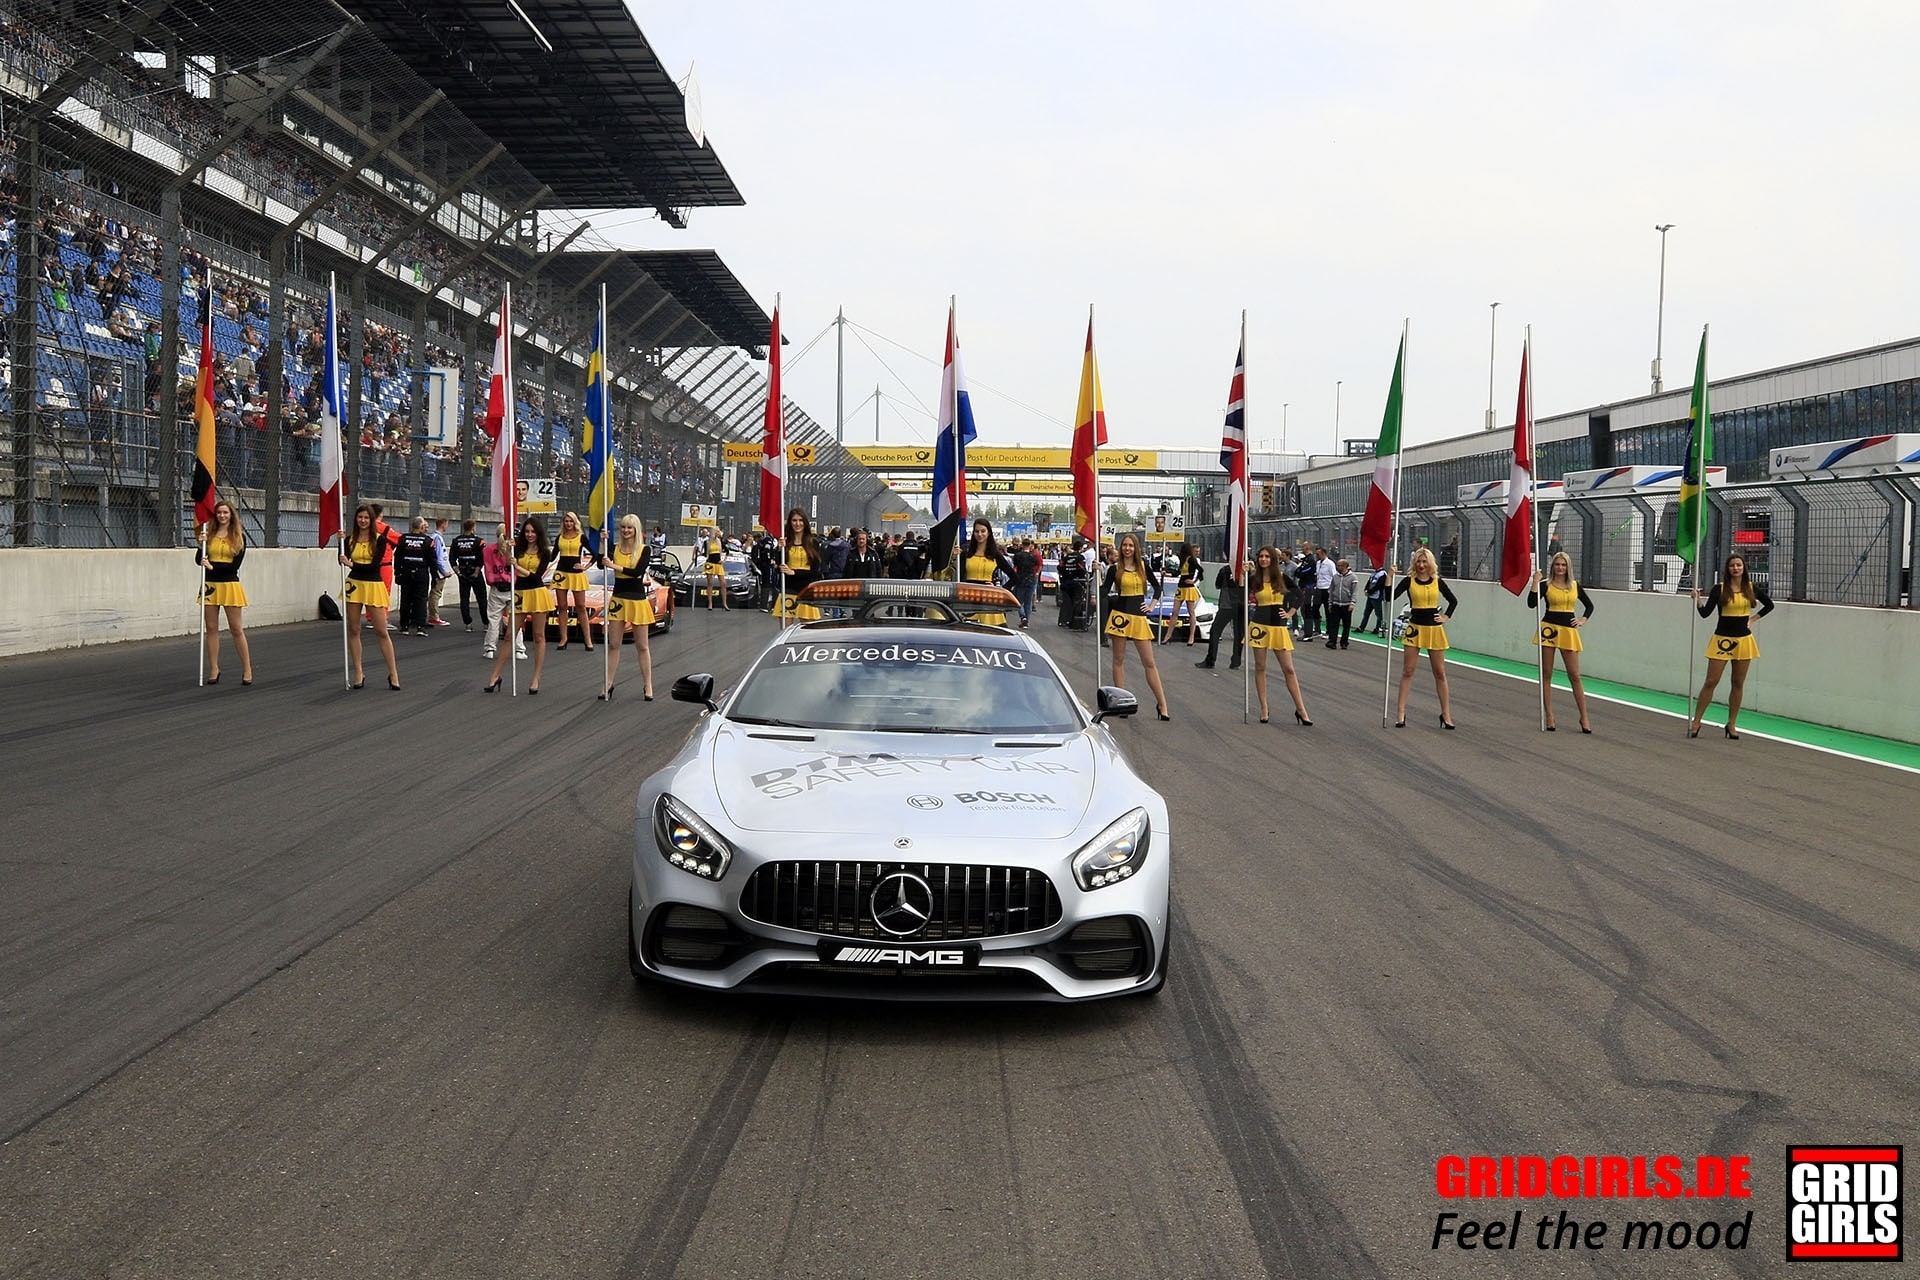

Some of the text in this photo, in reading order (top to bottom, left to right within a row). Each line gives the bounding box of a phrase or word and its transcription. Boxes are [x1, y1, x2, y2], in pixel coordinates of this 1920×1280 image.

[727, 449, 763, 459] Deutsch
[861, 454, 895, 462] Deutsche
[967, 454, 983, 462] Post
[985, 454, 998, 462] für
[1105, 457, 1121, 465] Post
[538, 481, 553, 495] 22
[986, 482, 1010, 490] DTM
[708, 507, 713, 516] 7
[1172, 516, 1184, 528] 25
[1106, 526, 1115, 535] 94
[780, 645, 1027, 670] Mercedes-AMG
[750, 752, 899, 789] DTM
[762, 757, 1079, 800] SAFETY CAR
[953, 791, 1056, 804] BOSCH
